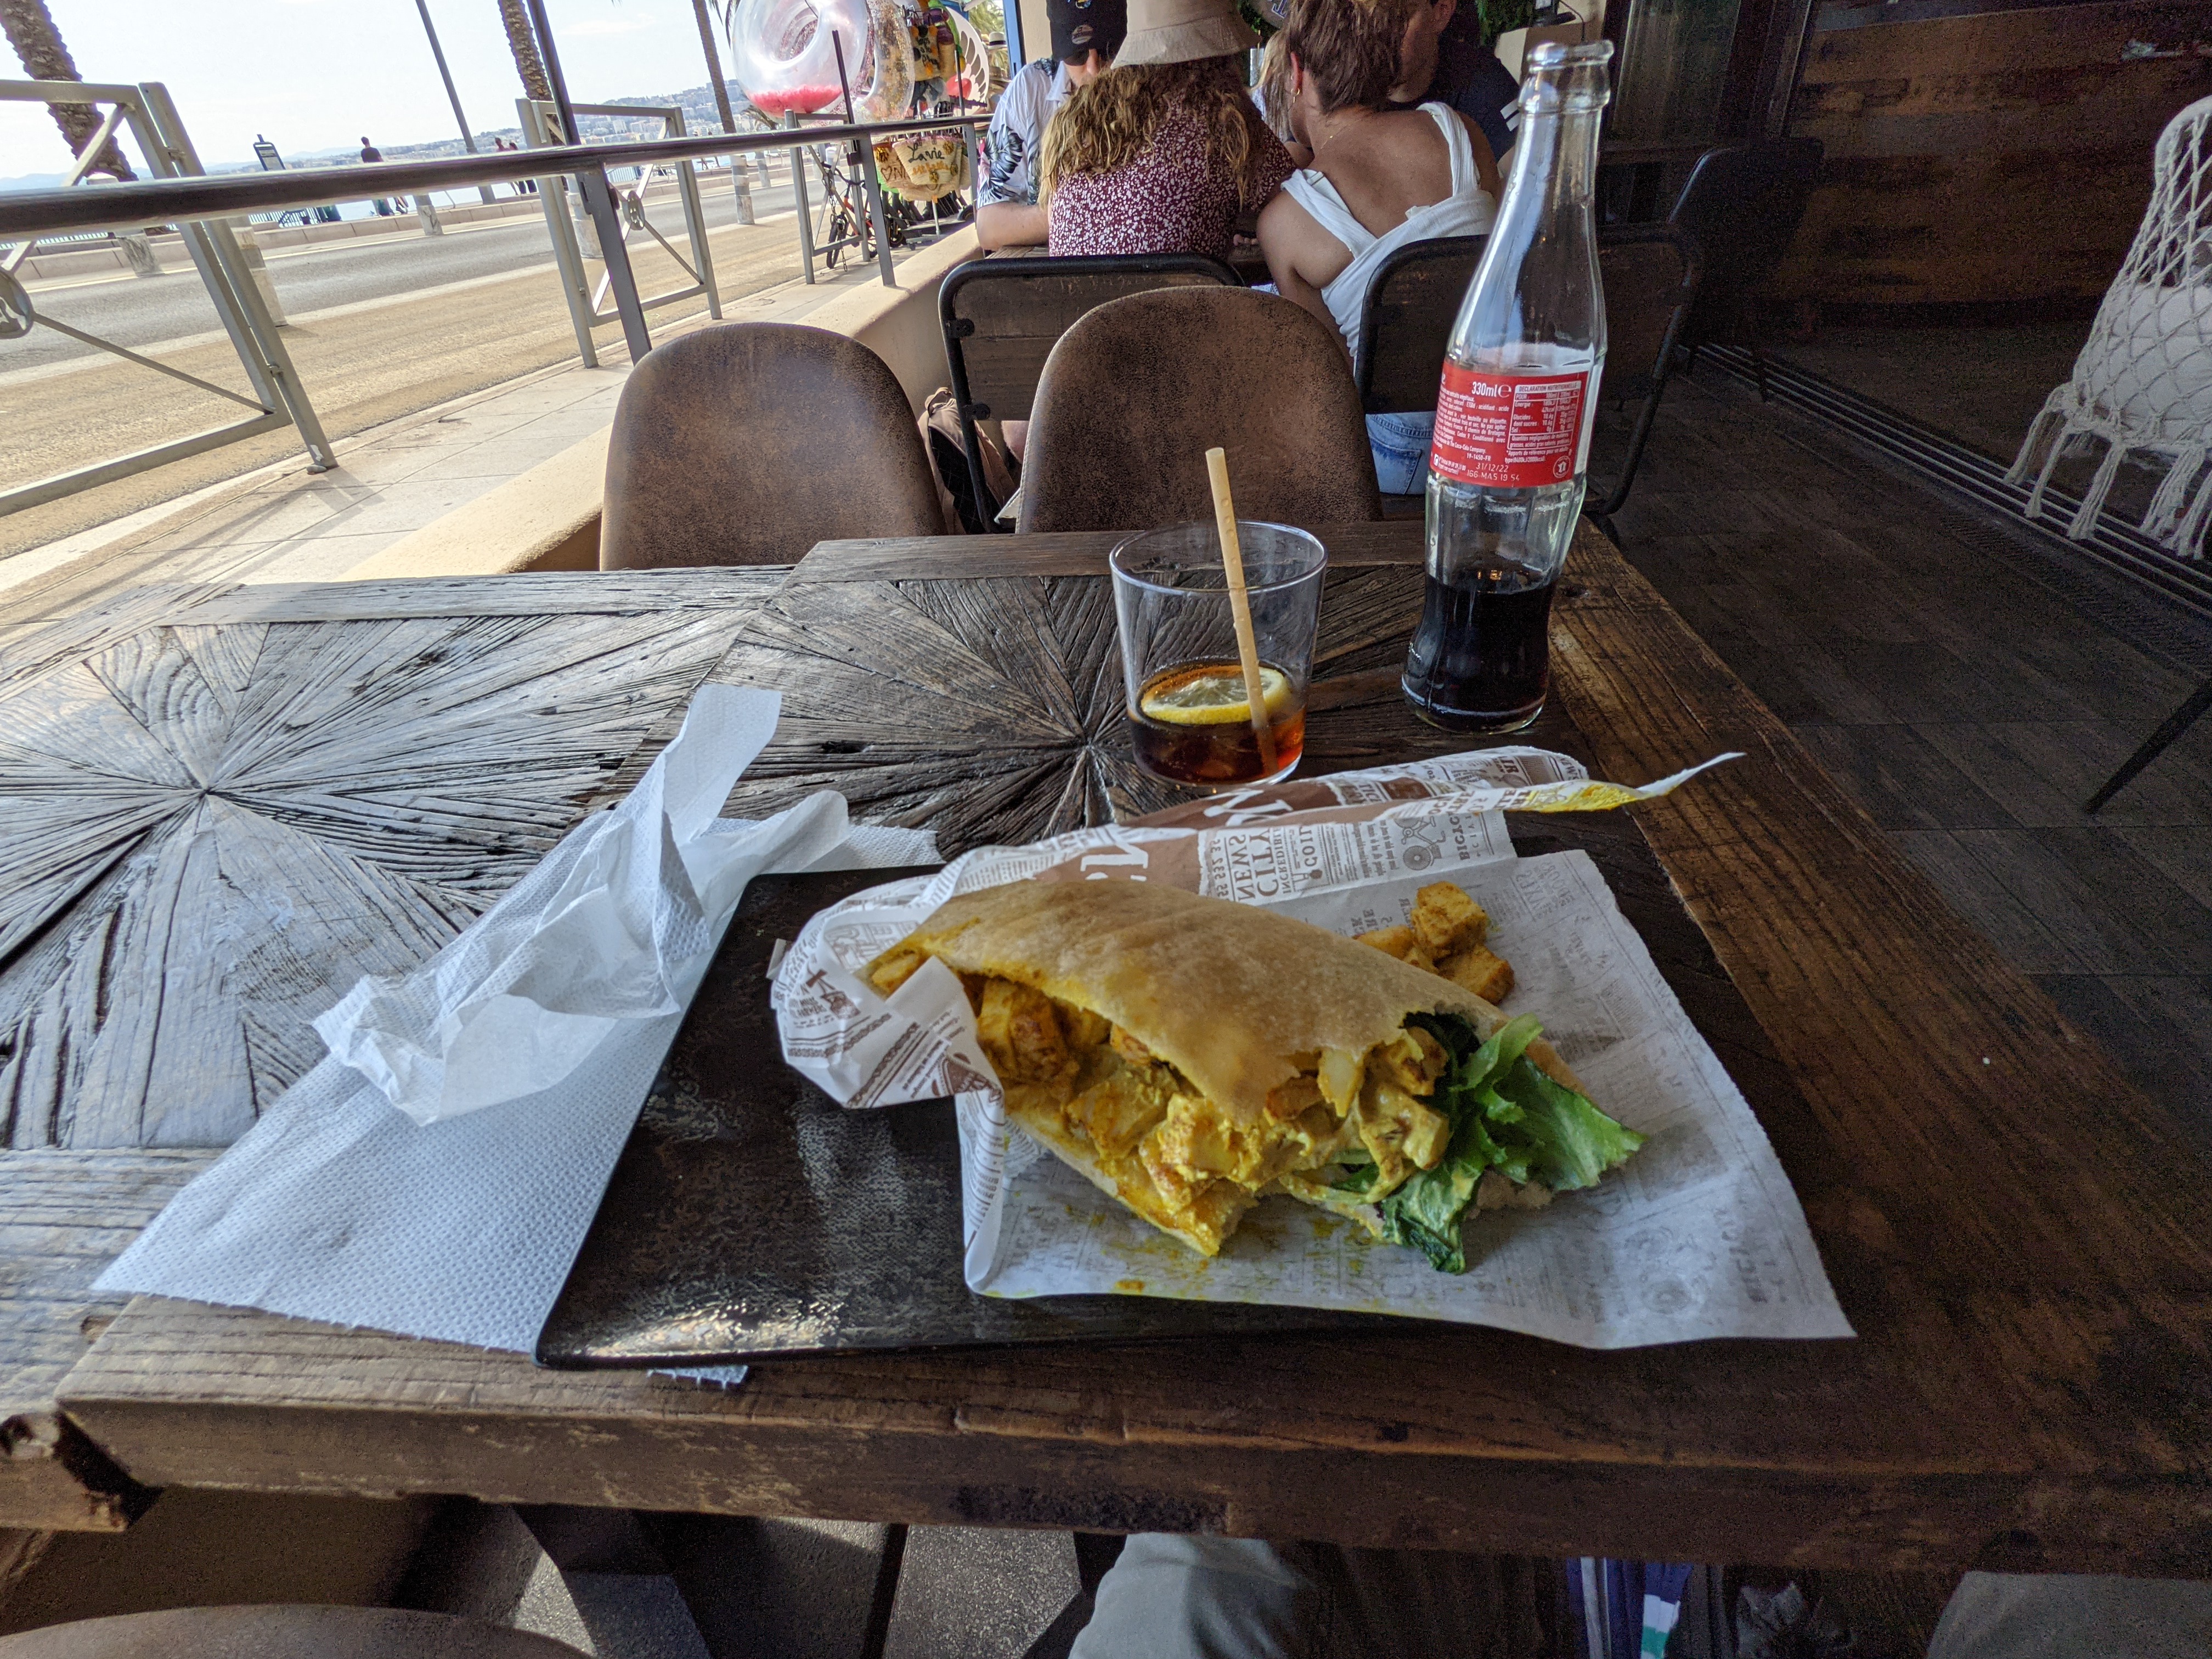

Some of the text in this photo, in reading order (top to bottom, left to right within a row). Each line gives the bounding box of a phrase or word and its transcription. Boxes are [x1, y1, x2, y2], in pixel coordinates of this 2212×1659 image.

[908, 141, 944, 163] La vie
[1471, 381, 1497, 397] 330ml
[1454, 442, 1469, 450] Coca-Cola
[1476, 462, 1509, 472] 31/12/22
[1467, 469, 1479, 478] 166
